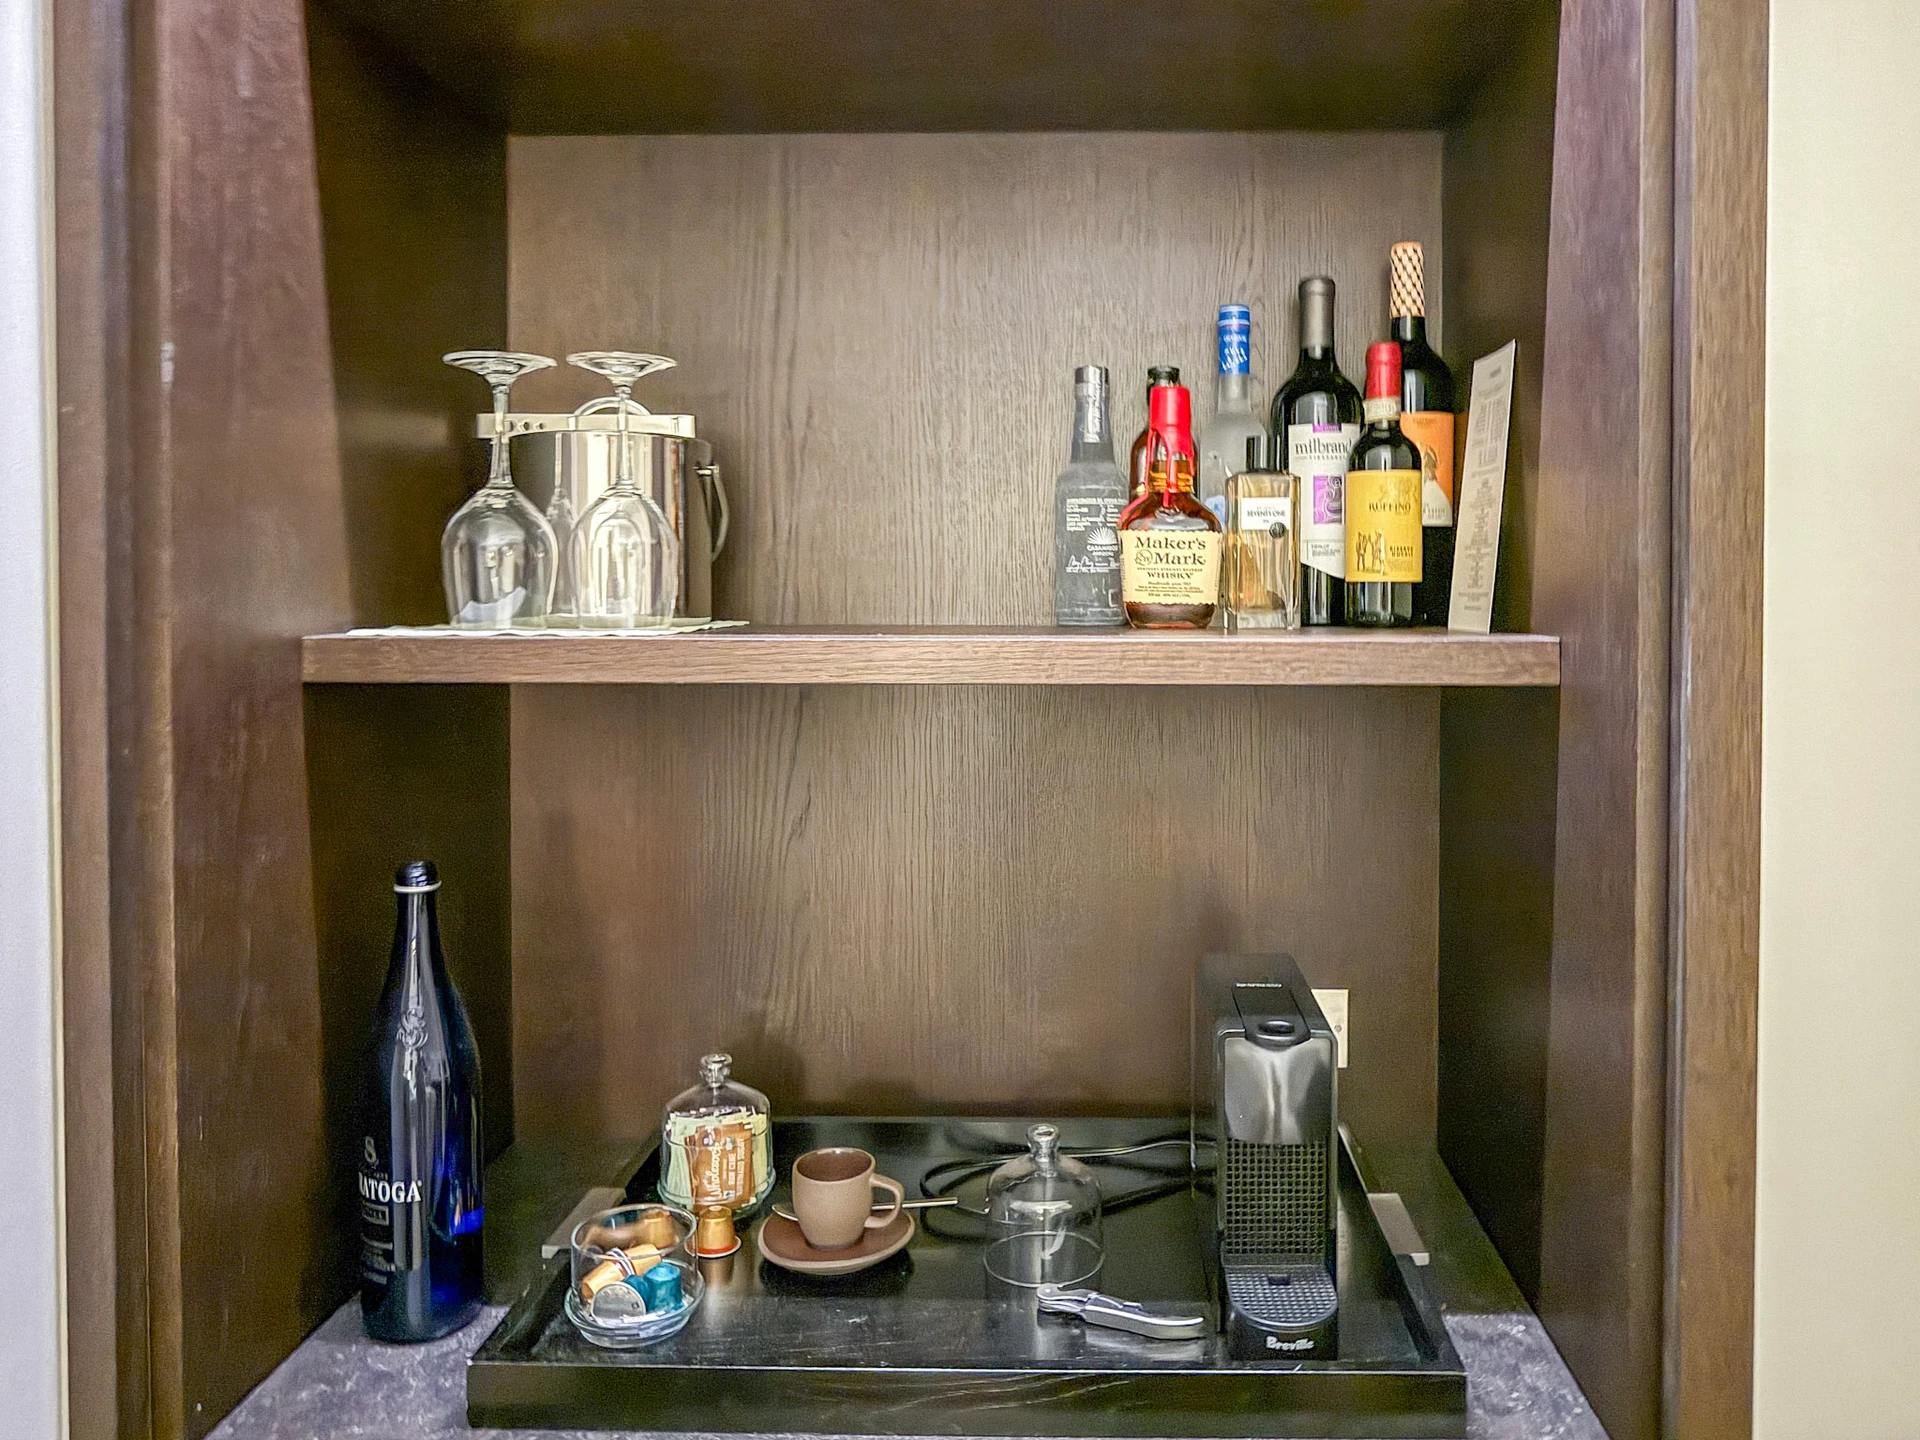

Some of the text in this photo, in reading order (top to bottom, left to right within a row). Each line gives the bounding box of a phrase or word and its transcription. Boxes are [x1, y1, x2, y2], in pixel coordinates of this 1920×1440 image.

[1369, 502, 1412, 513] RUFFINO
[1134, 535, 1207, 551] Maker's
[1153, 551, 1207, 566] Mark
[1147, 571, 1191, 579] WHISKY
[1266, 1335, 1315, 1351] Breville
